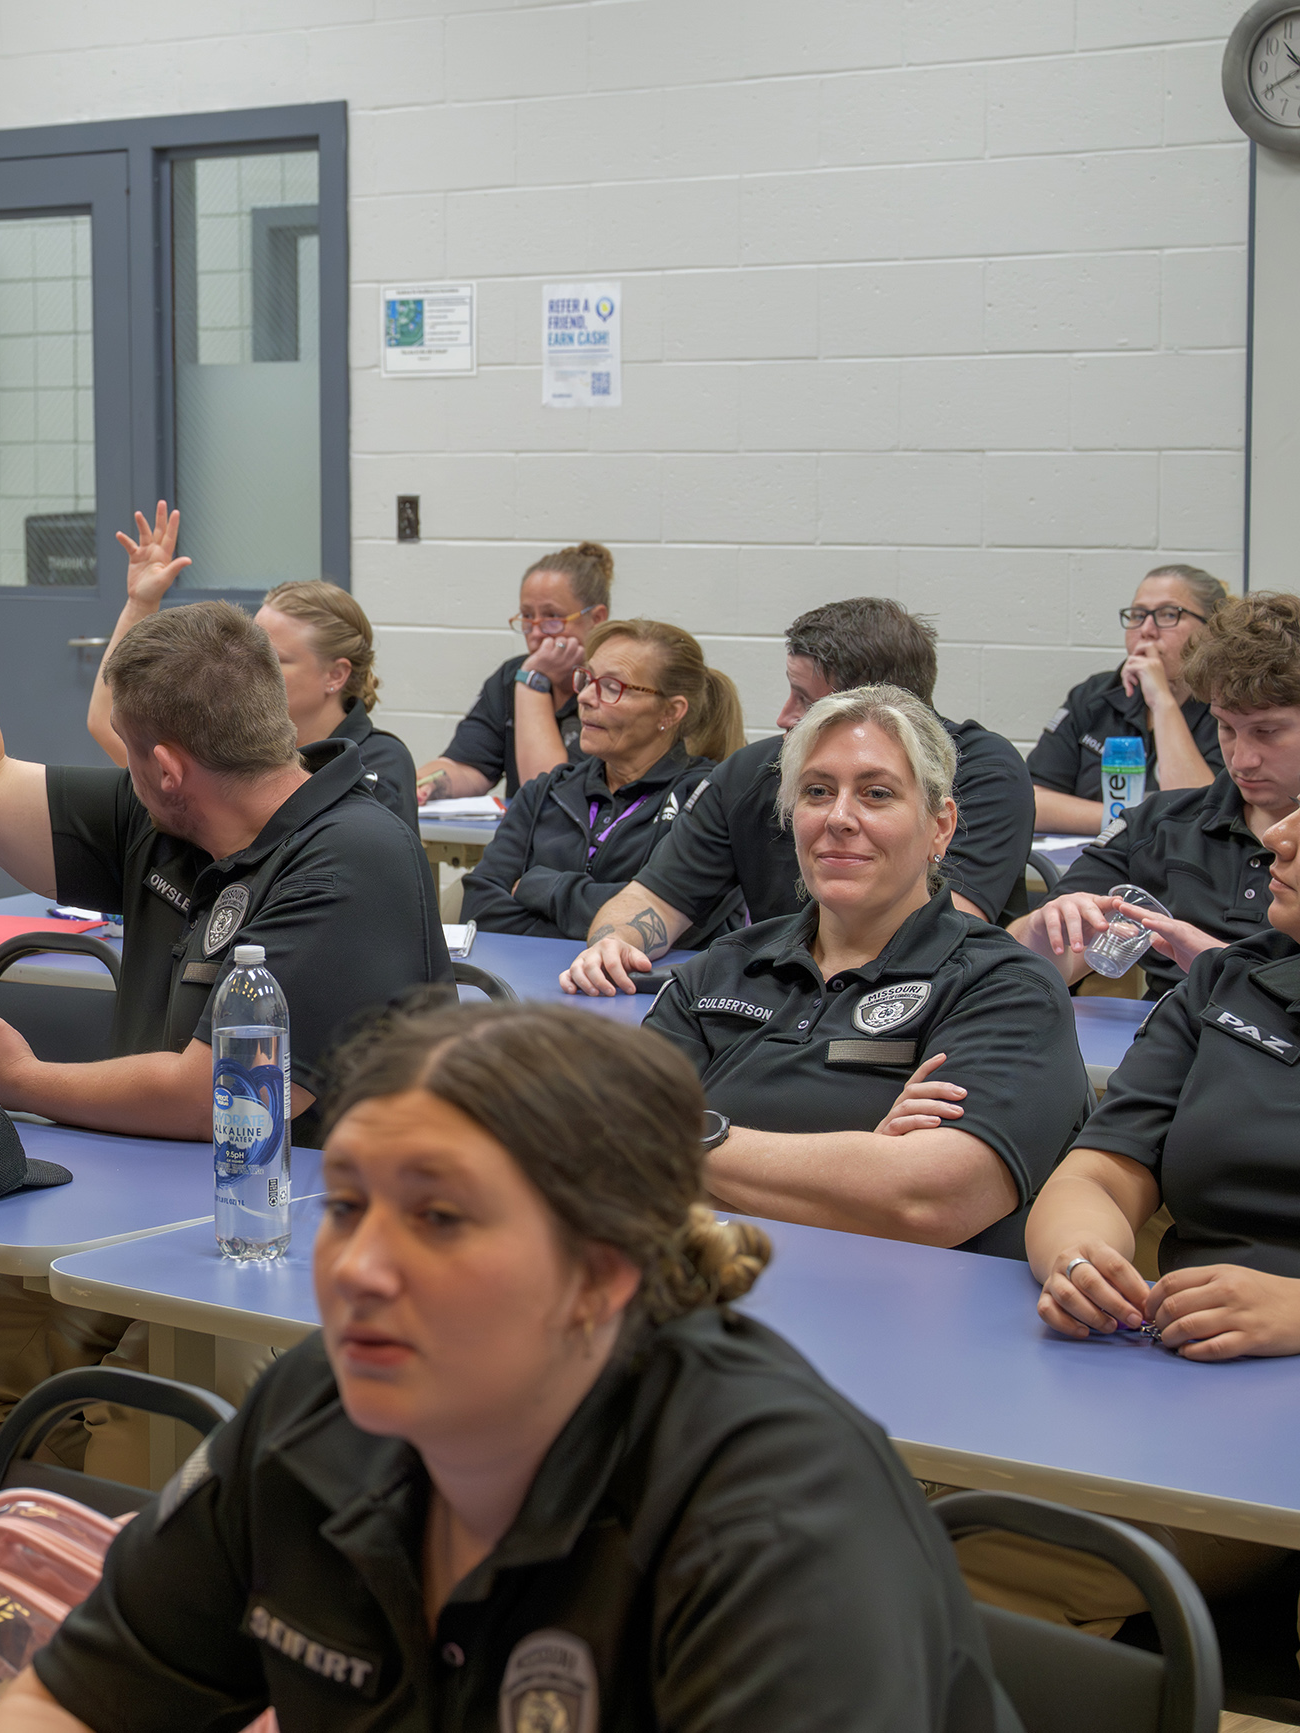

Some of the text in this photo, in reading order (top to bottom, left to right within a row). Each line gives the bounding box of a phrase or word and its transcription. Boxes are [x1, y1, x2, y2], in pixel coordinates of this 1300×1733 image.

[1284, 21, 1293, 39] 11
[1266, 37, 1279, 56] 10
[1280, 98, 1289, 117] 7
[548, 298, 590, 314] REFER A
[548, 331, 576, 346] EARN
[1109, 774, 1126, 825] ore
[868, 985, 923, 1002] MISSOURI
[698, 998, 774, 1021] CULBERTSON
[1217, 1011, 1293, 1055] PAZ
[215, 1111, 265, 1128] HYDRATE
[214, 1124, 262, 1137] ALKALINE
[225, 1150, 245, 1160] 9.5pH
[250, 1606, 373, 1689] SEIFERT
